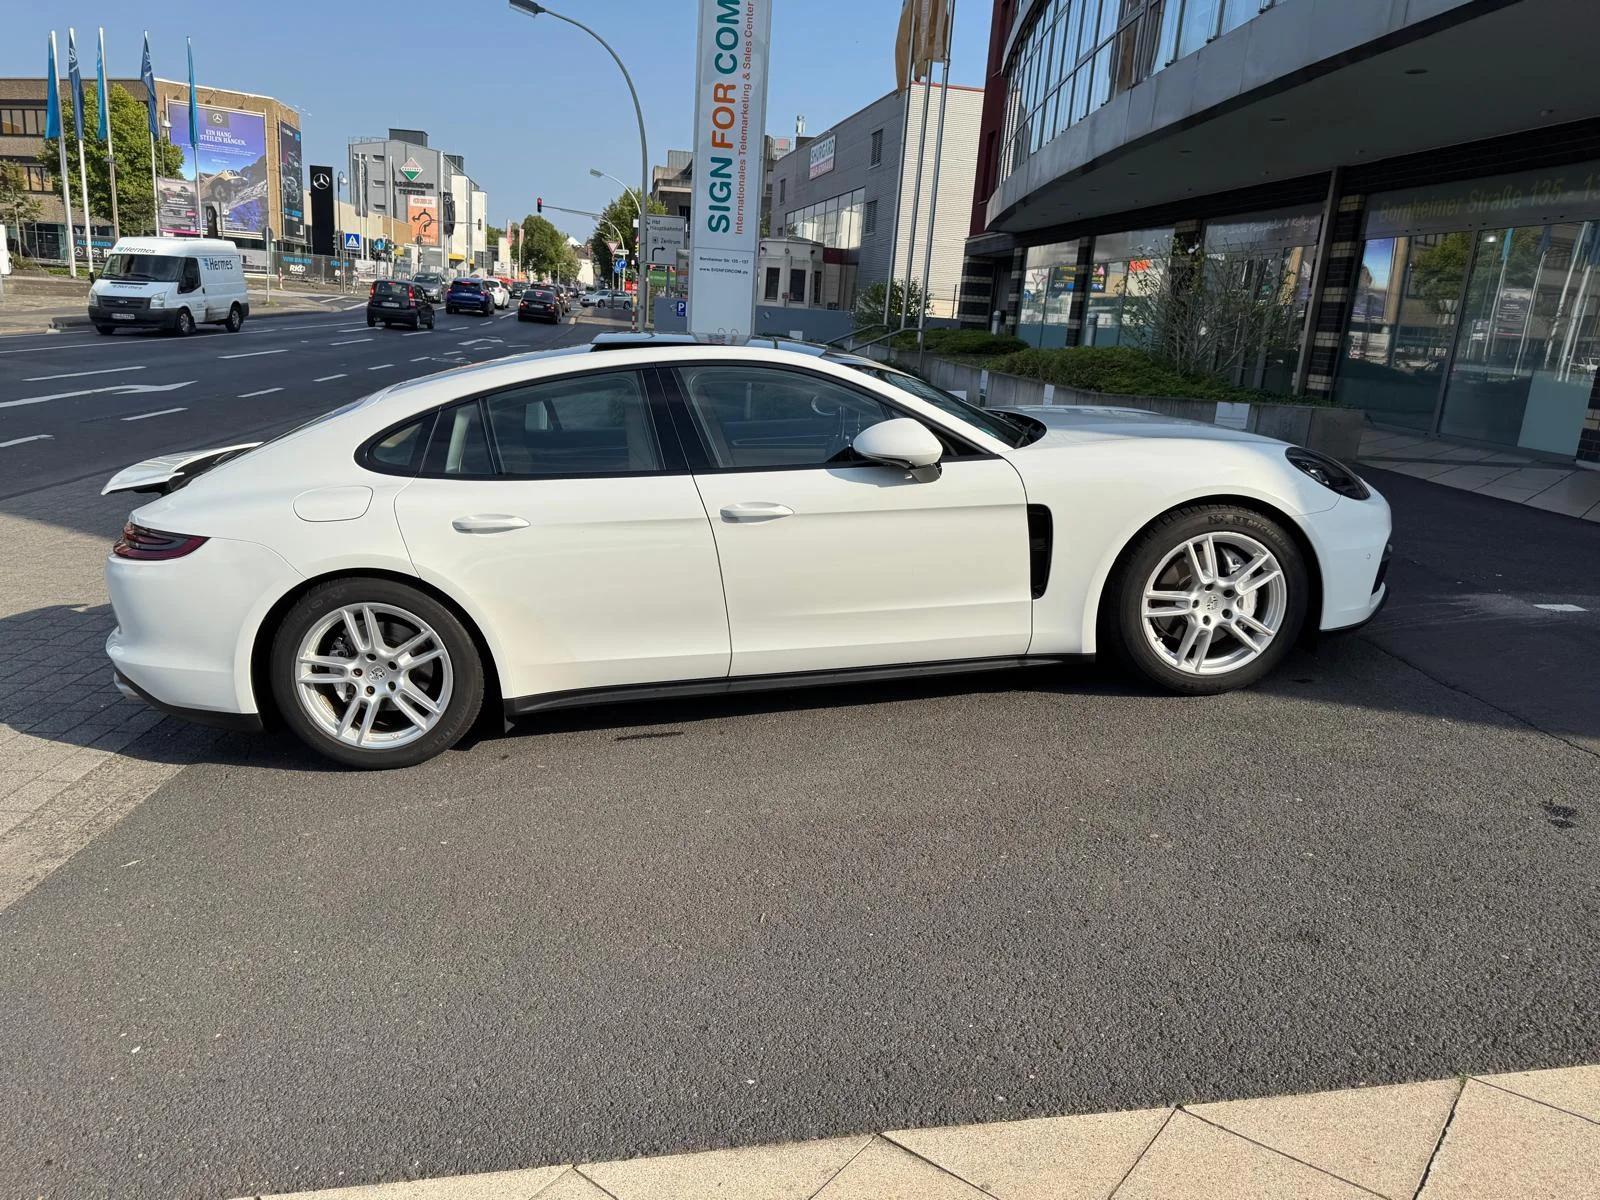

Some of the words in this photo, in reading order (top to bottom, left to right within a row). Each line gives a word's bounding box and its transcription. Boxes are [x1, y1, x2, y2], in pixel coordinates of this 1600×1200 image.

[744, 0, 755, 38] Center
[714, 0, 740, 75] COM
[743, 40, 753, 70] Sales
[742, 72, 751, 81] &
[711, 83, 737, 150] FOR
[738, 83, 752, 156] Telemarketing
[707, 156, 733, 234] SIGN
[735, 159, 746, 235] Internationales
[1466, 184, 1523, 216] Straße
[122, 246, 157, 254] Hermes
[208, 257, 233, 271] Hermes
[677, 302, 685, 311] P
